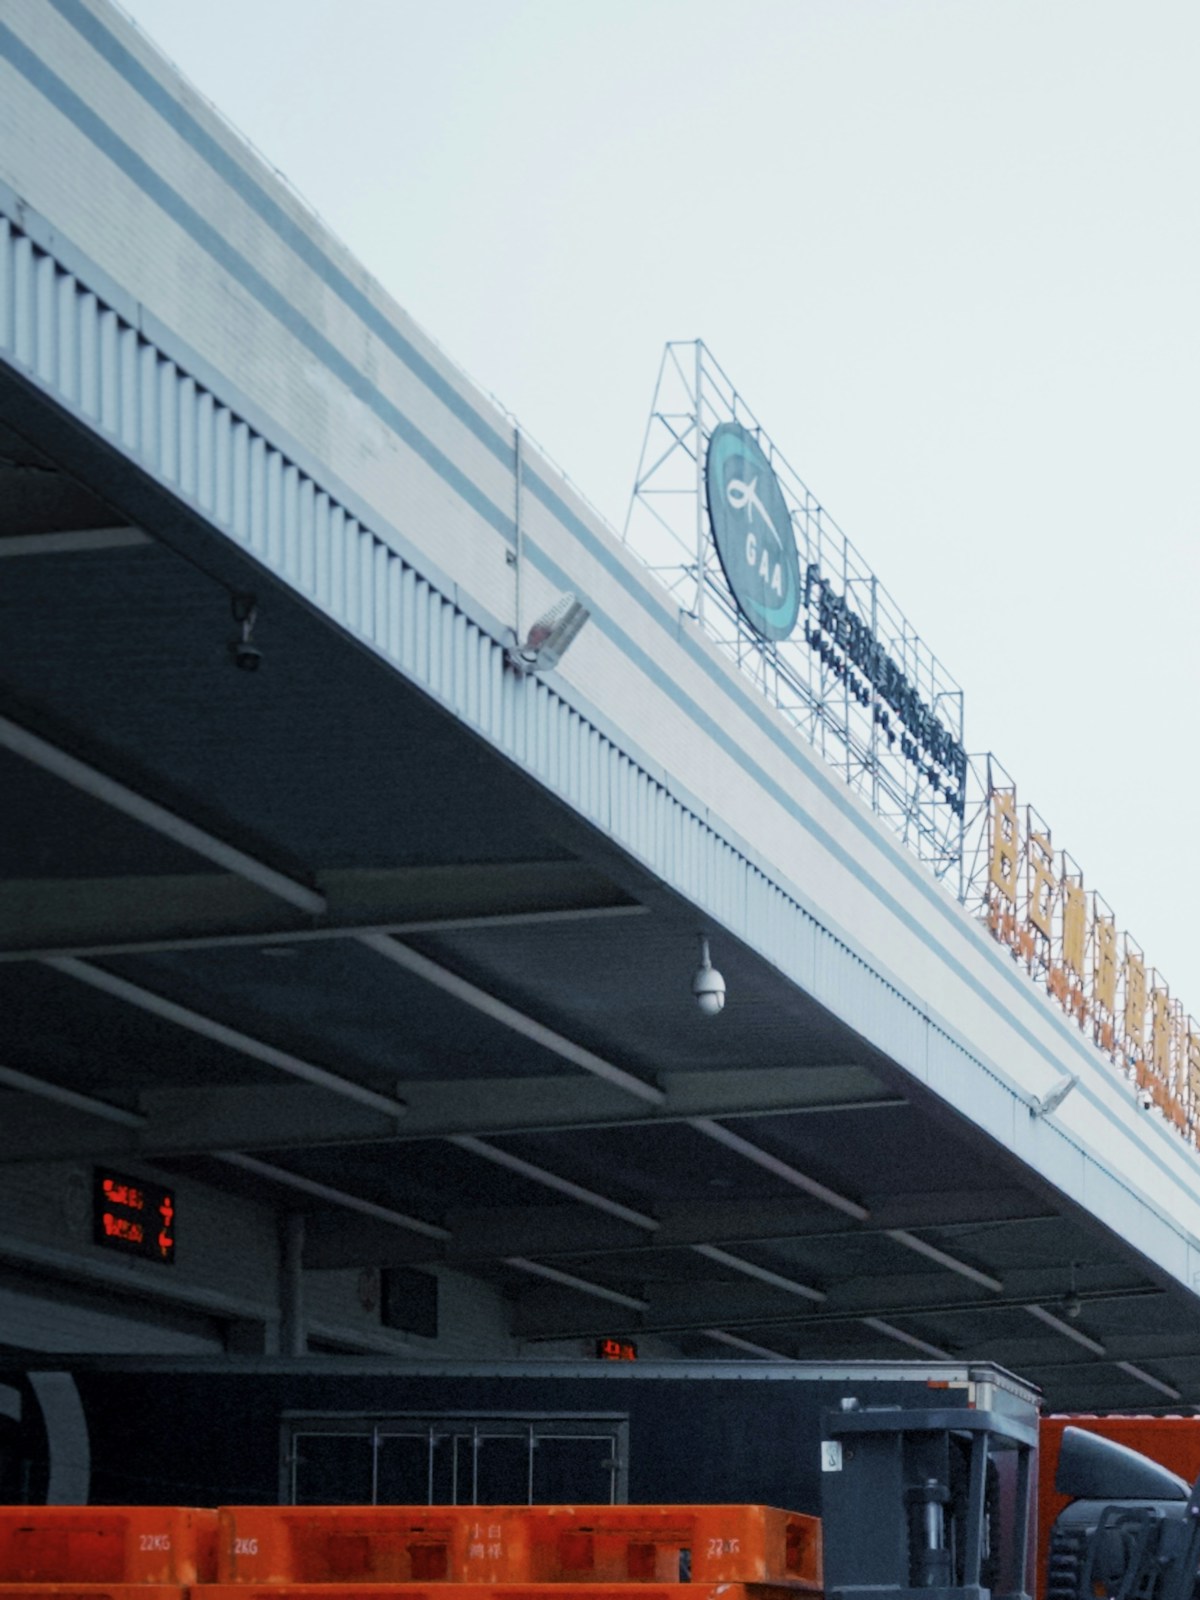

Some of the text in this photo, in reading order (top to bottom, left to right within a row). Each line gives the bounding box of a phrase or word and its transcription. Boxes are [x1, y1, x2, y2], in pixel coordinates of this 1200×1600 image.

[746, 532, 782, 597] GAA
[140, 1535, 170, 1551] 22KG
[228, 1538, 258, 1556] 2KG
